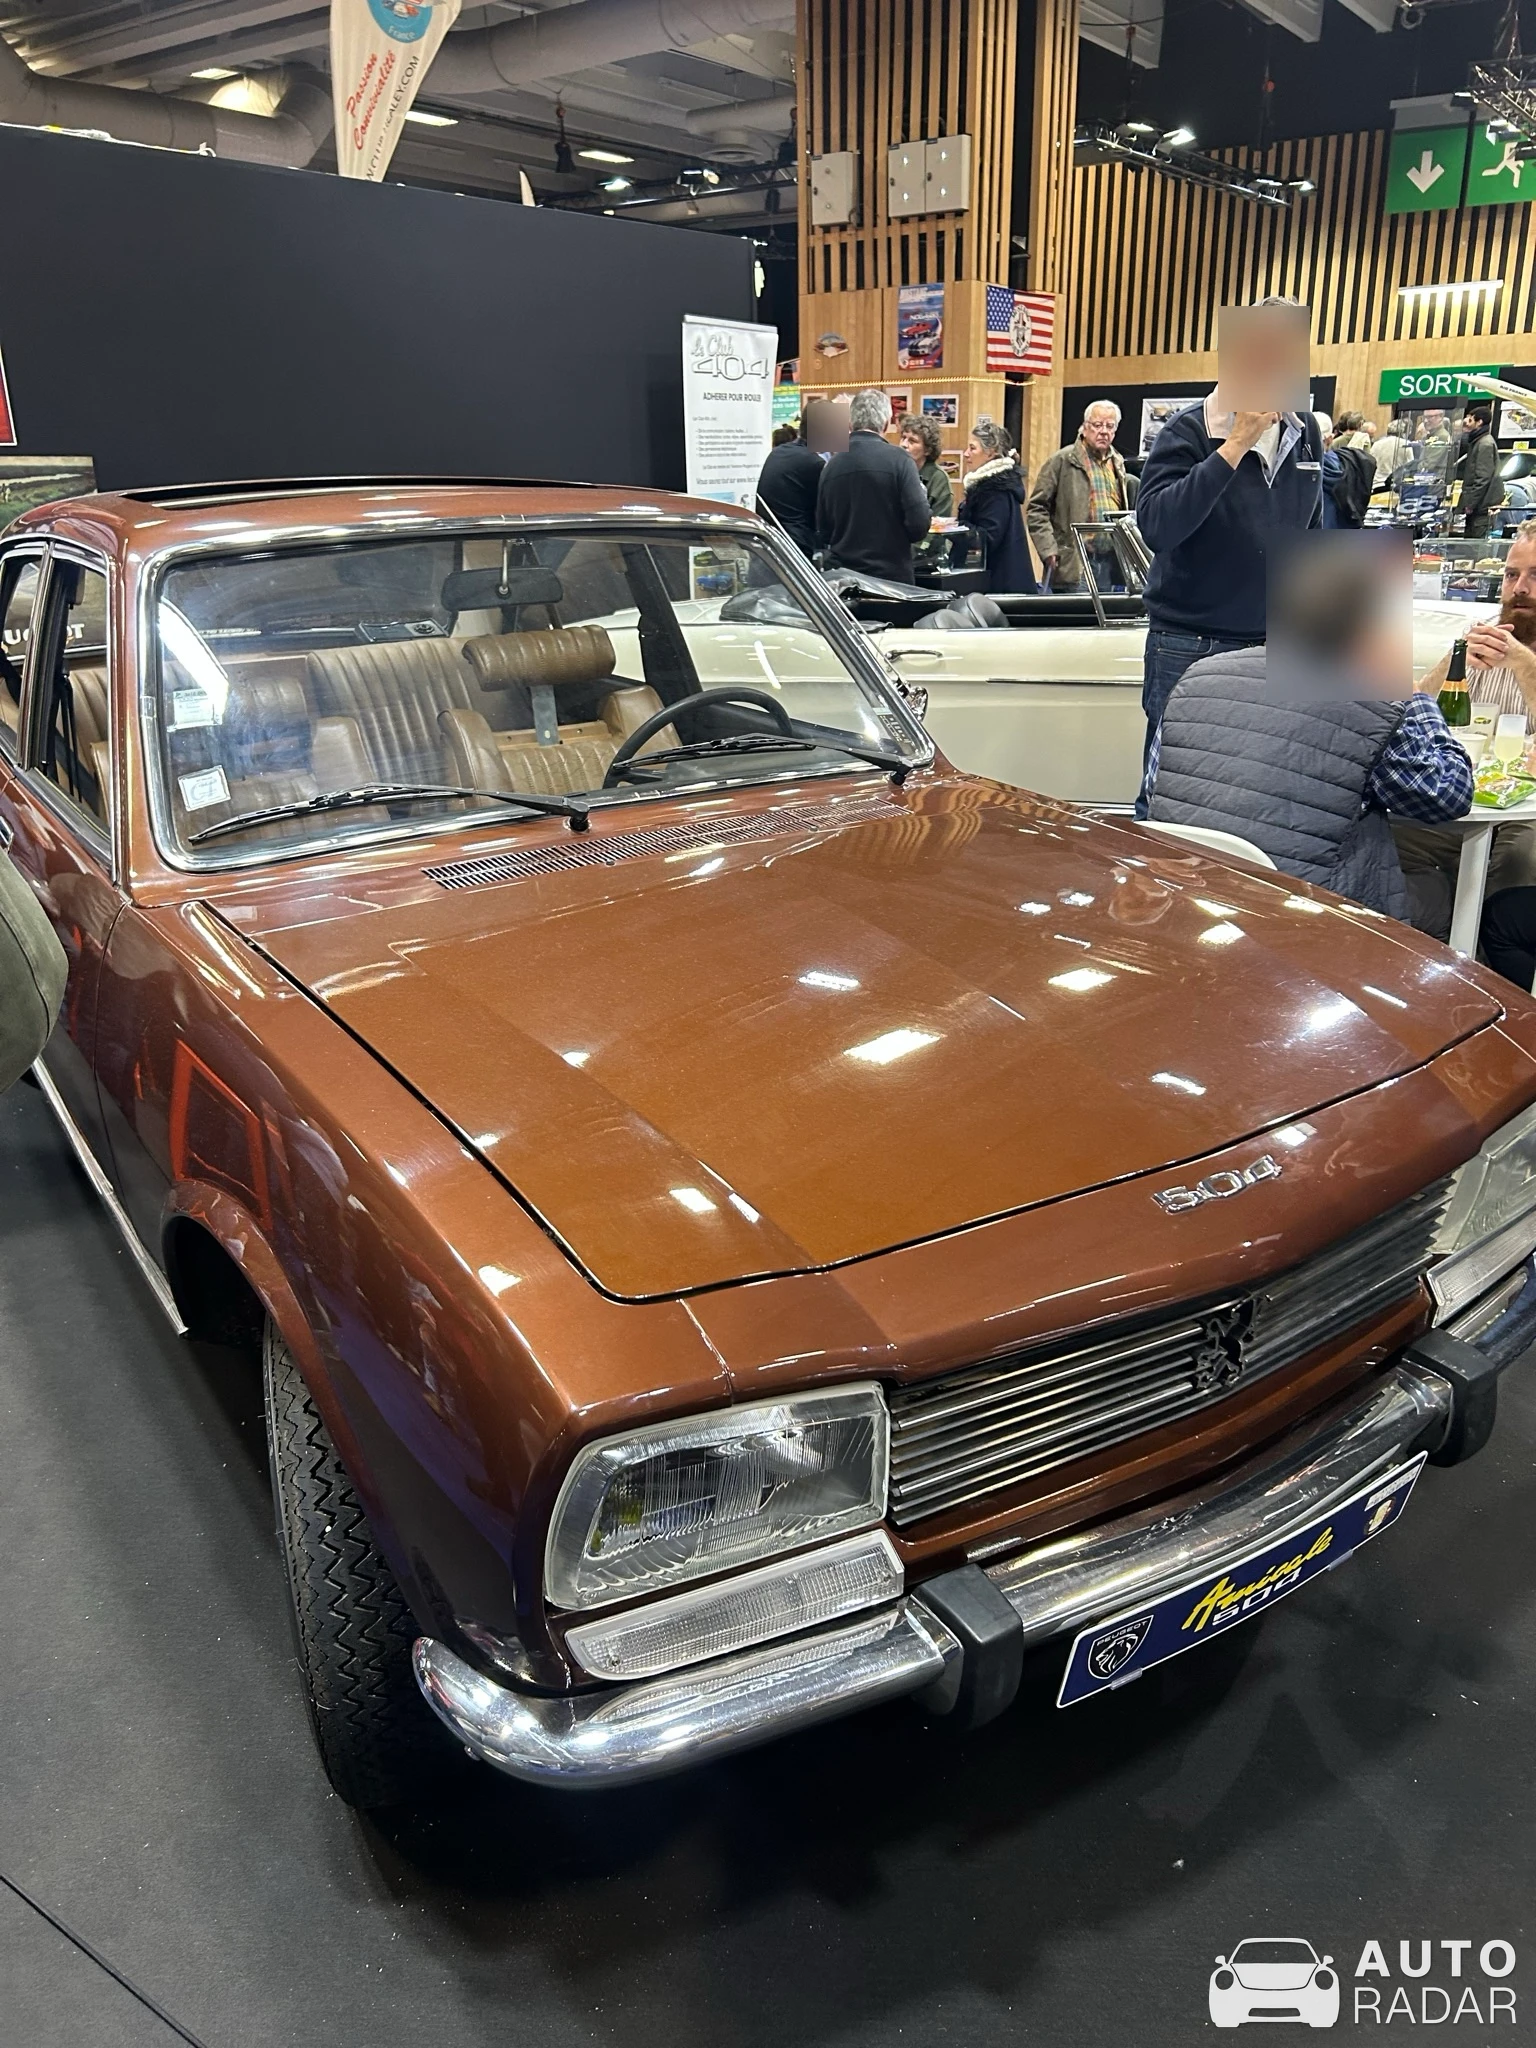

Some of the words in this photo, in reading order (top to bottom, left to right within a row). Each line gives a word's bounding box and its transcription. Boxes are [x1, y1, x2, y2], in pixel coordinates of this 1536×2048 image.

[347, 53, 378, 119] Passion
[707, 334, 734, 357] Club
[692, 356, 769, 381] 404
[729, 392, 743, 401] POUR
[1150, 1154, 1283, 1215] 504
[1181, 1526, 1334, 1633] Amicale
[1212, 1566, 1302, 1626] 504
[1096, 1620, 1148, 1646] PEUGEOT
